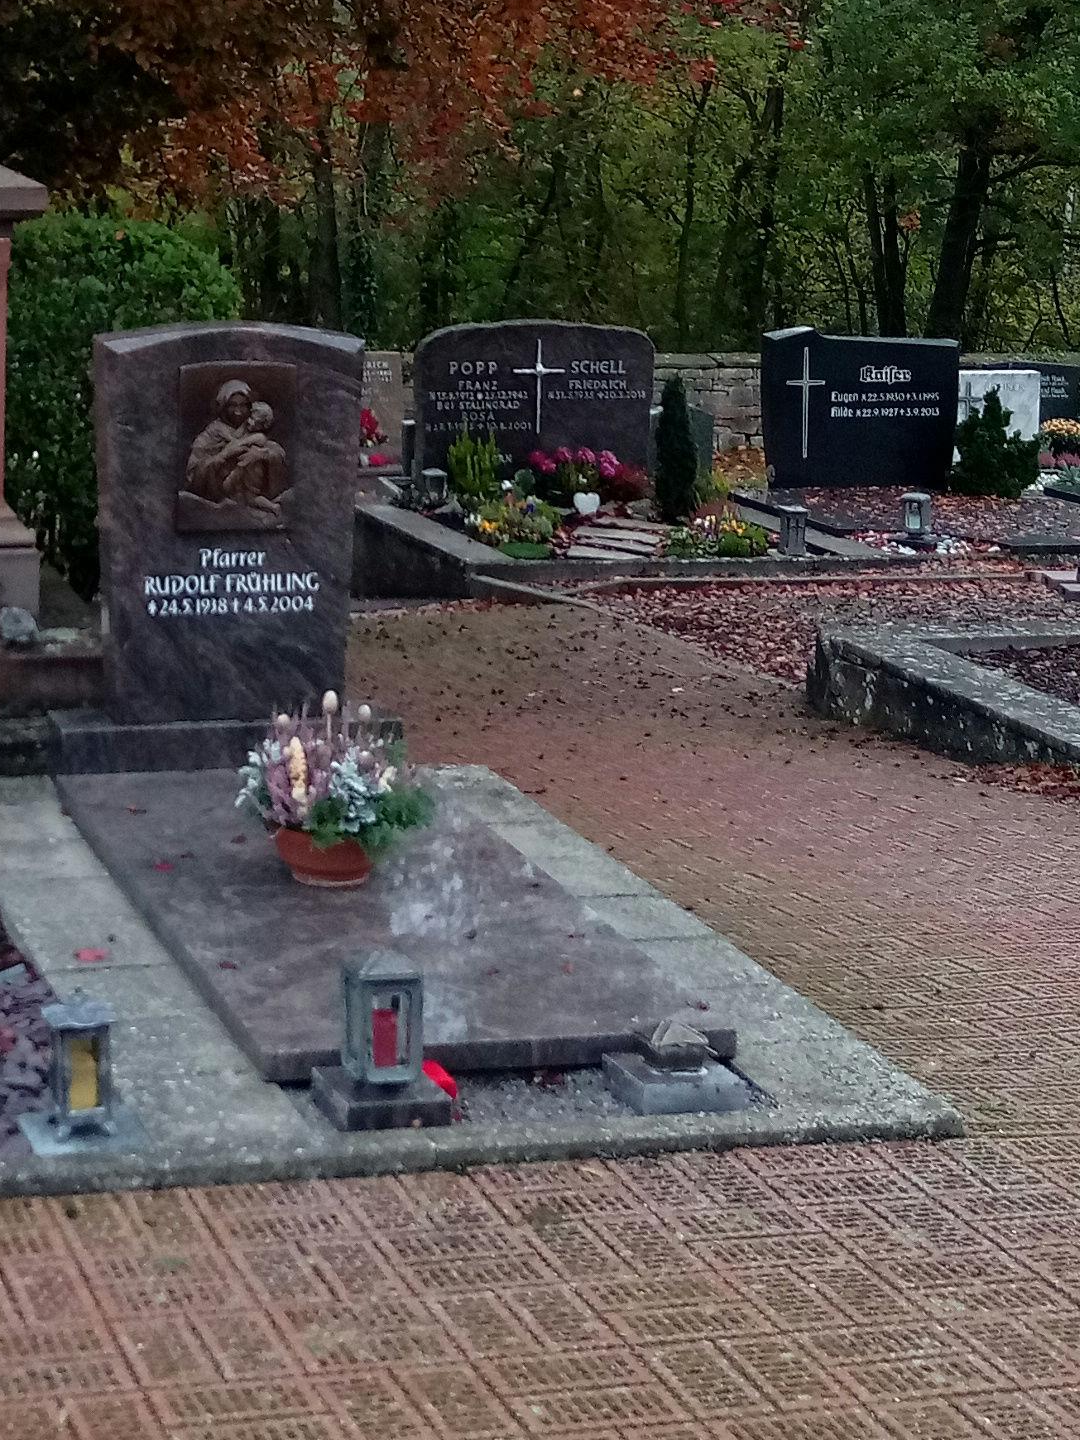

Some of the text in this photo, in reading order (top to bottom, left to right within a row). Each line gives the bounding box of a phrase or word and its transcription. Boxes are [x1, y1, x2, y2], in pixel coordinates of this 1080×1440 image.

[449, 361, 498, 375] POPP
[570, 359, 627, 374] SCHELL
[458, 380, 498, 391] FRANZ
[567, 379, 627, 390] FRIEDRICH
[831, 391, 859, 403] Eugen
[459, 400, 521, 411] STALINGRAD
[199, 548, 267, 568] Pfarrer
[144, 571, 320, 596] RUDOLF FRÜHLING
